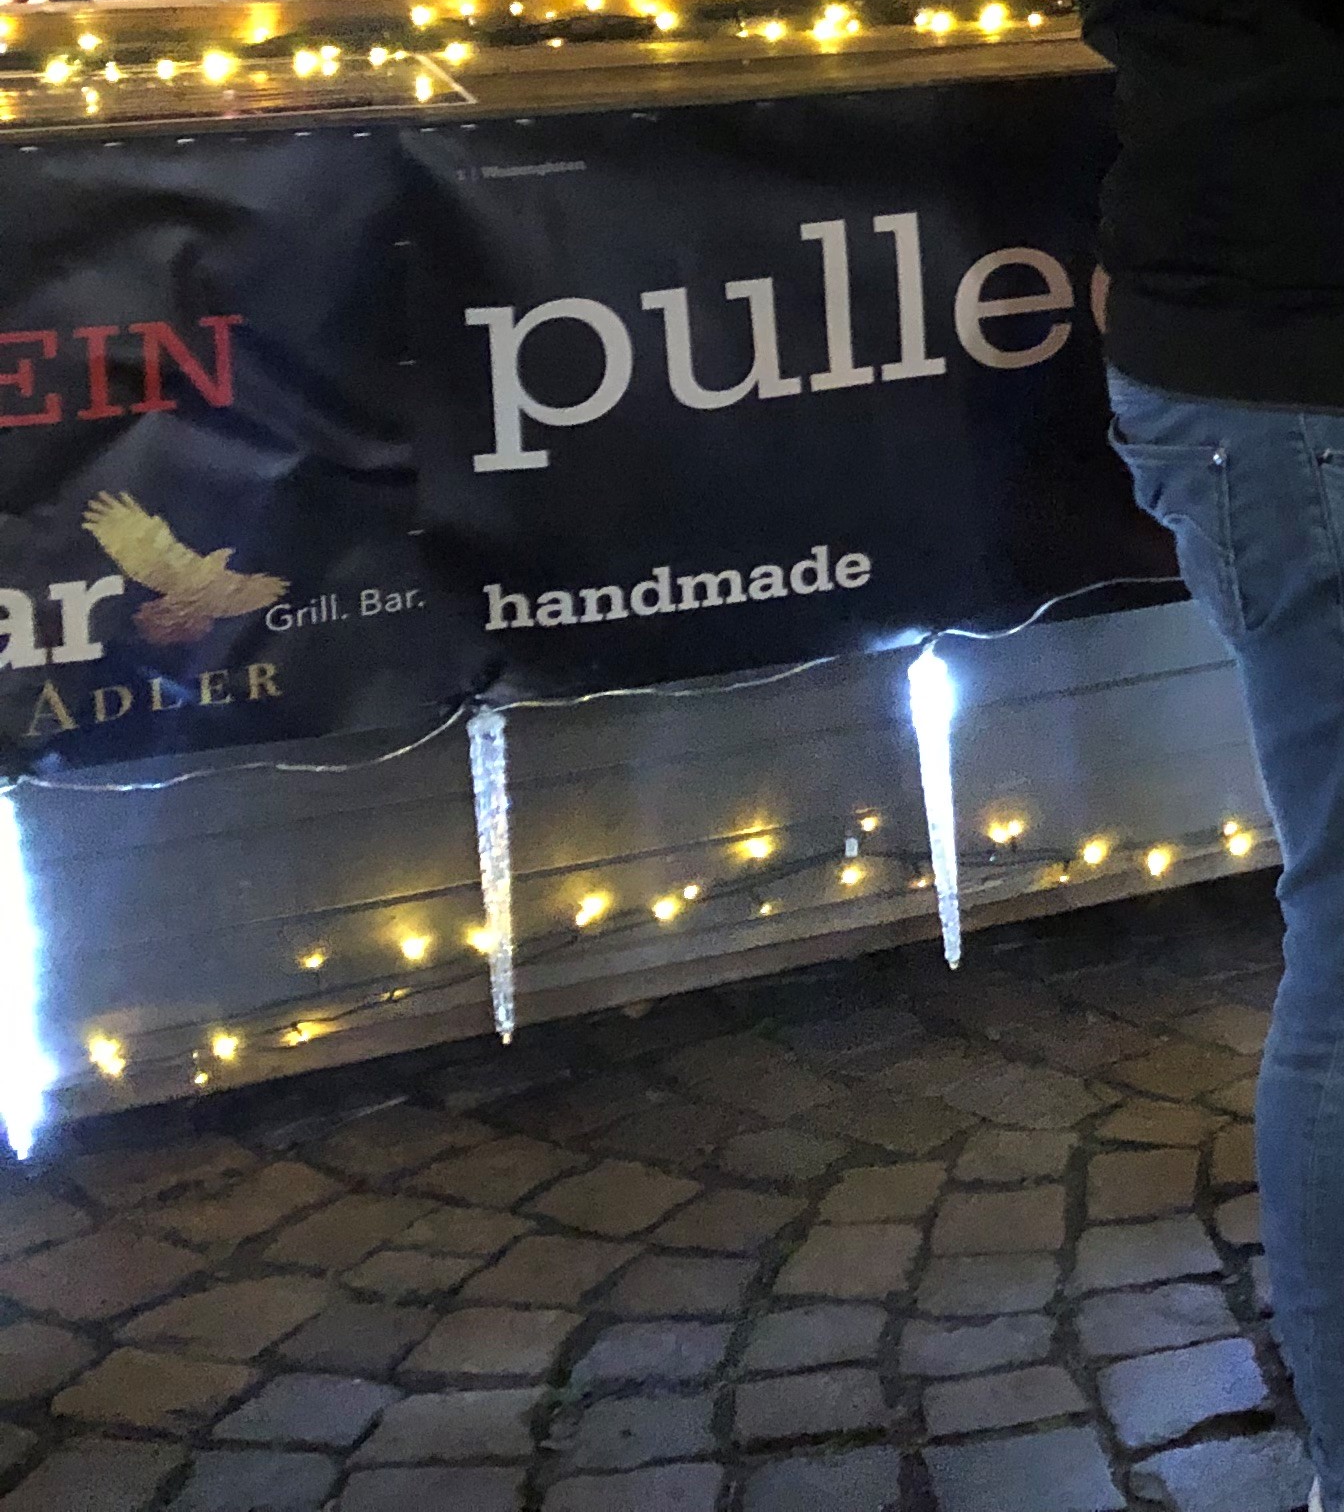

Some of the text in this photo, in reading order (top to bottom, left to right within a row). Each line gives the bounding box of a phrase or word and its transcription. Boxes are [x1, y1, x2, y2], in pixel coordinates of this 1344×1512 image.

[0, 314, 245, 428] EIN
[465, 212, 1112, 473] pulle
[265, 588, 425, 632] Grill. Bar.
[483, 544, 872, 631] handmade
[24, 662, 283, 737] ADLER
